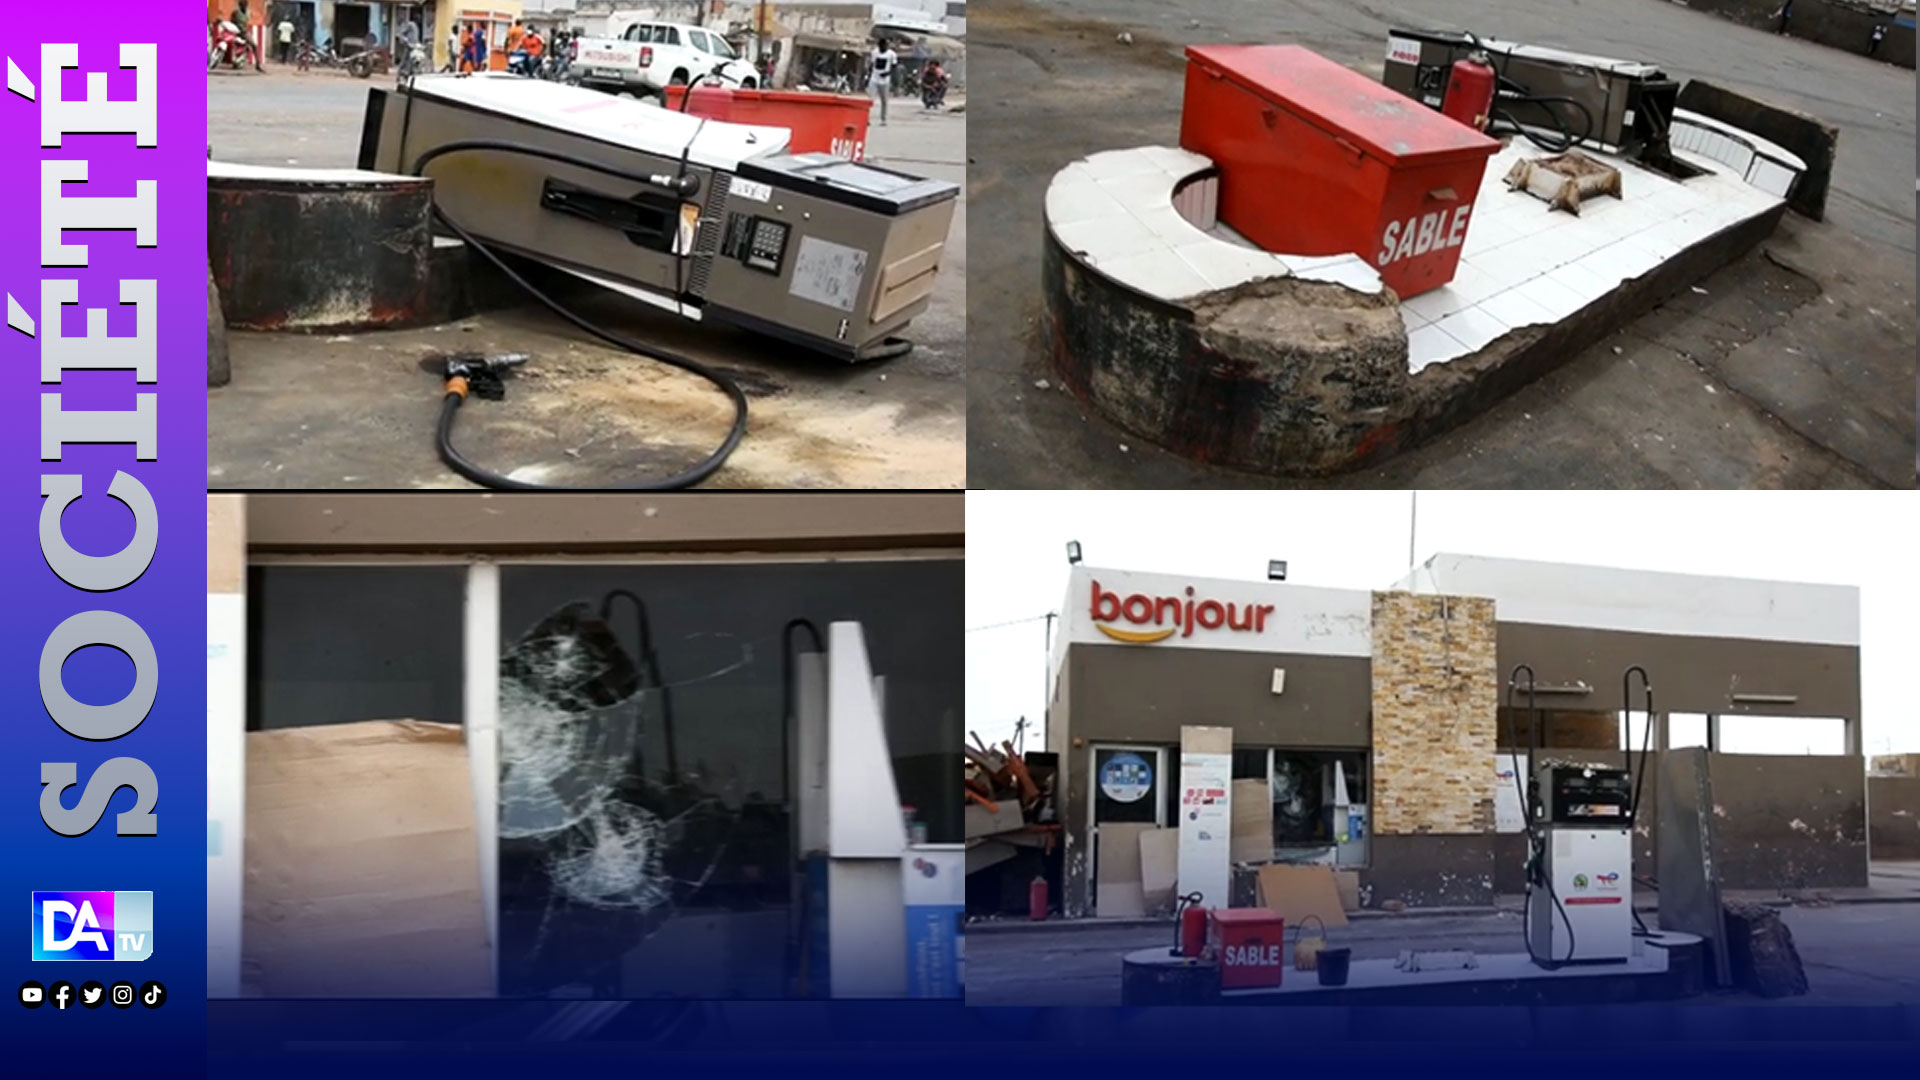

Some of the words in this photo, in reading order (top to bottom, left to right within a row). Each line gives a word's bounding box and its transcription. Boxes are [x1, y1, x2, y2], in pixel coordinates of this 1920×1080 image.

[1377, 204, 1470, 267] SABLE
[1090, 580, 1275, 639] bonjour
[1224, 944, 1281, 967] SABLE
